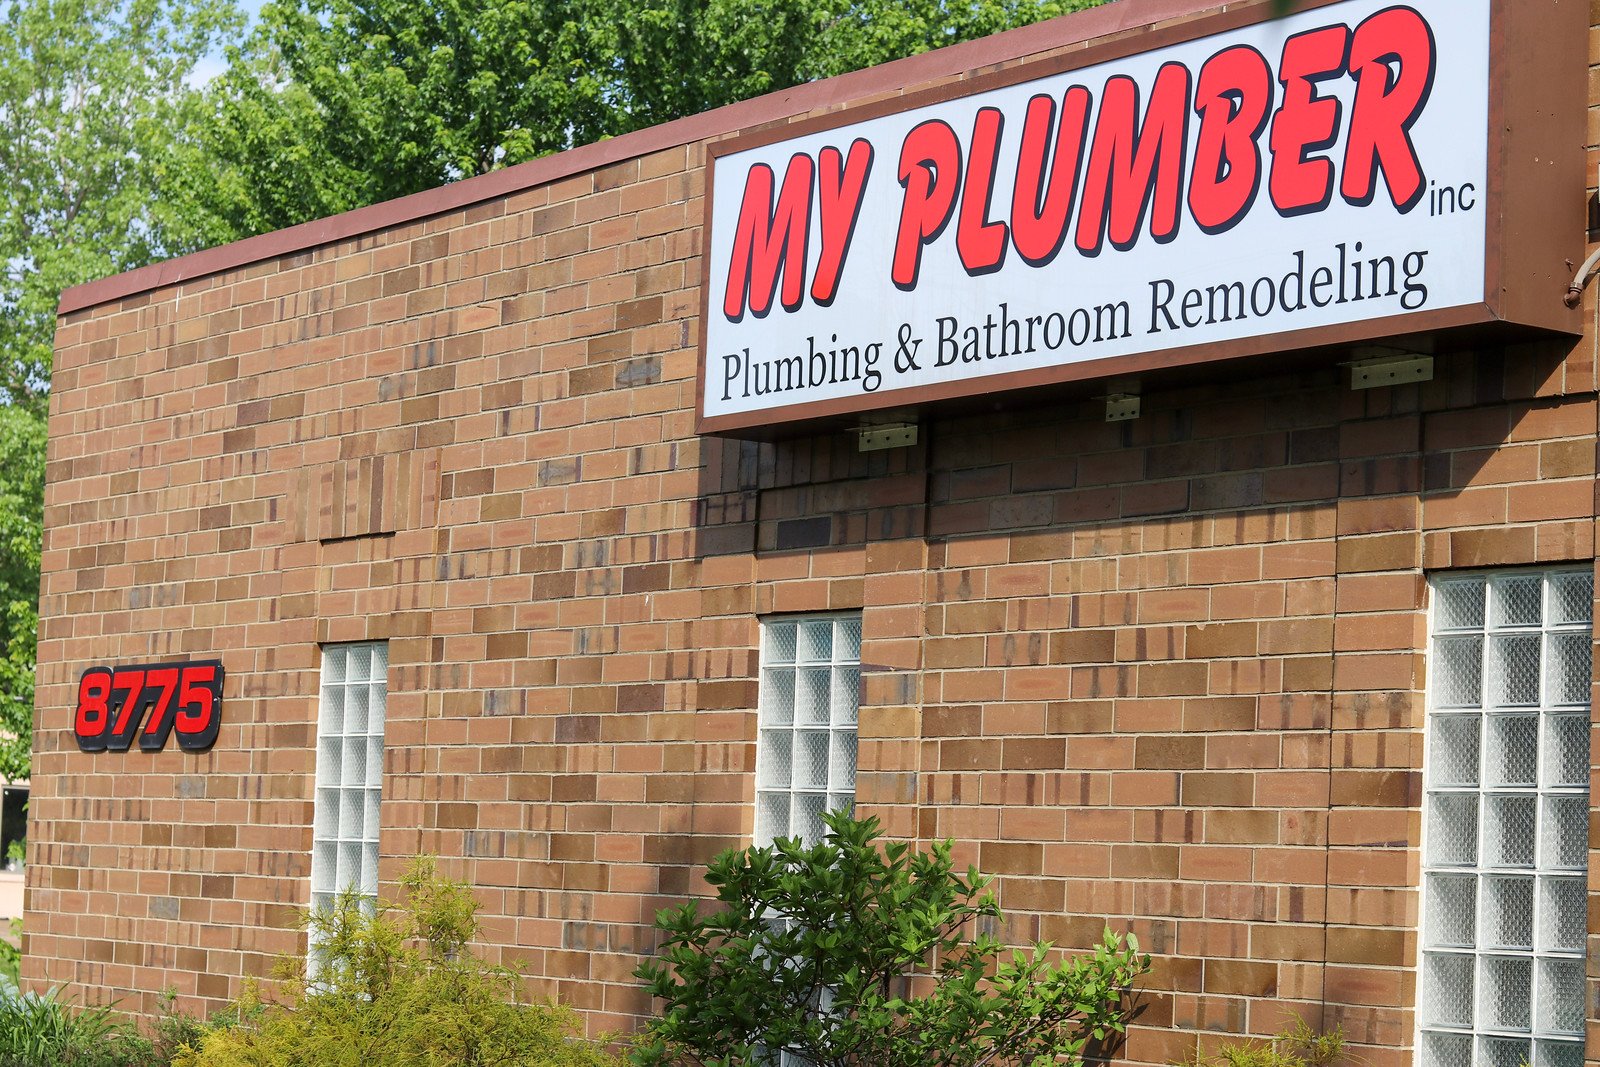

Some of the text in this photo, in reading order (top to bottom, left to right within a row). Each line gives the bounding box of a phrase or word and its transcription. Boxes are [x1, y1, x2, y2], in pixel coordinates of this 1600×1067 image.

[723, 4, 1476, 323] MY PLUMBER inc
[721, 241, 1429, 401] Plumbing & Bathroom Remodeling
[75, 664, 218, 741] 8775
